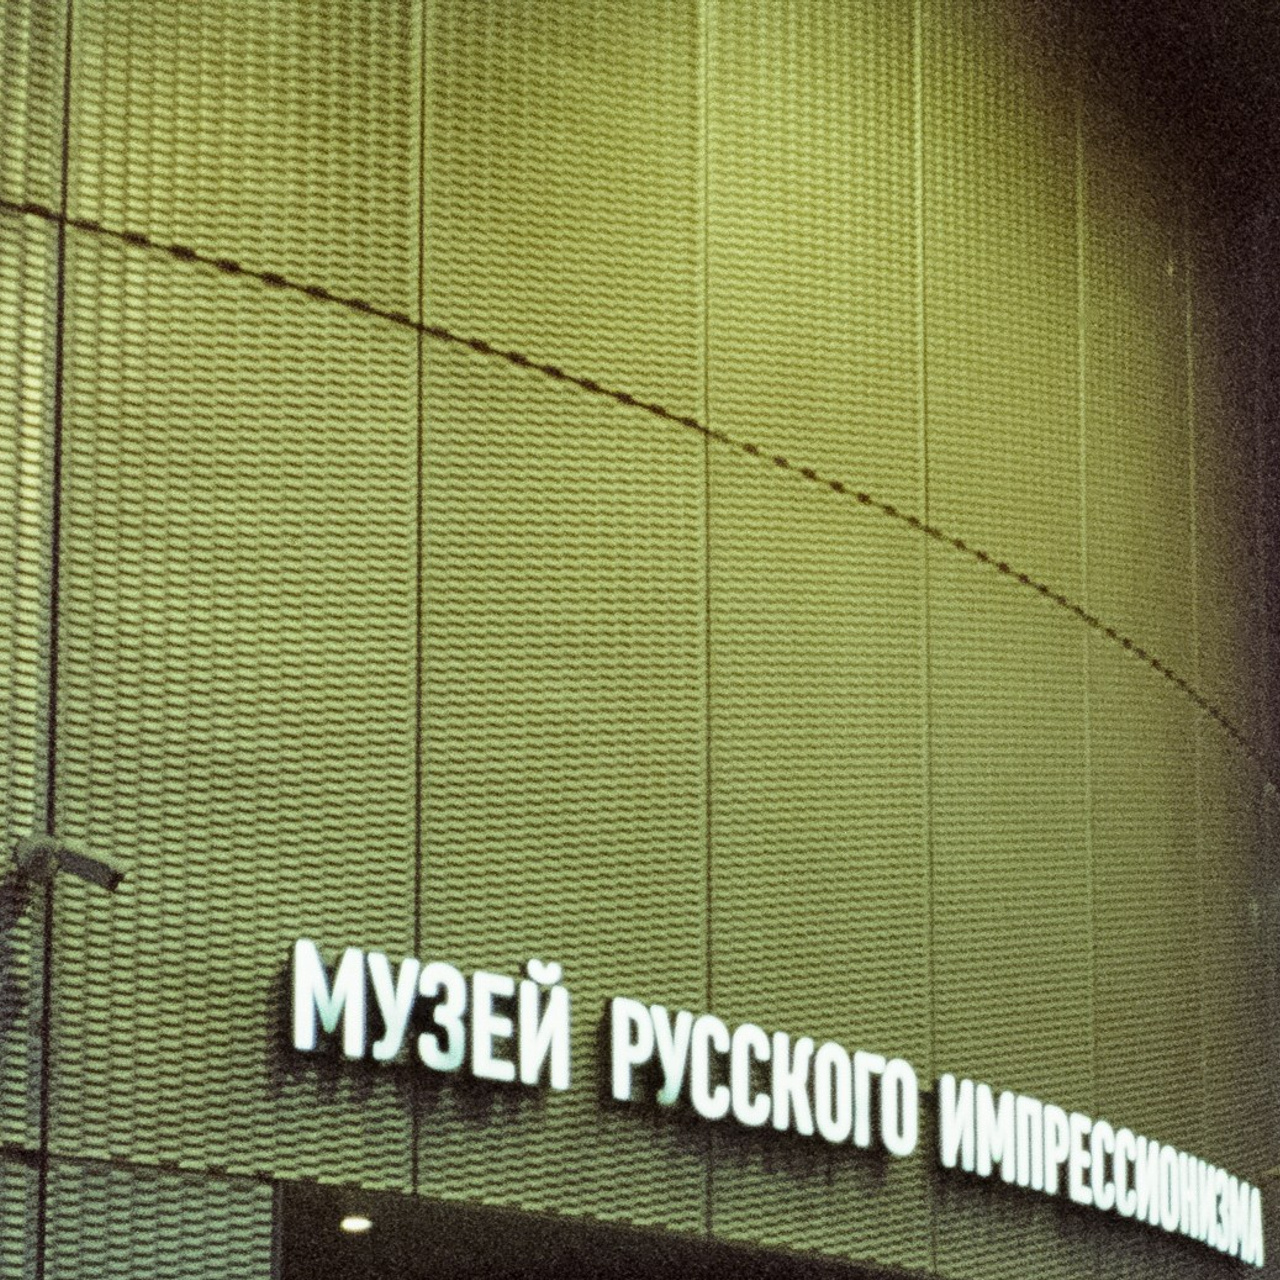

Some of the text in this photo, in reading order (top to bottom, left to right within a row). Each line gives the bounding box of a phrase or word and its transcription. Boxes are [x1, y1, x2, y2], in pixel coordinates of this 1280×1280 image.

[293, 938, 1266, 1269] МУЗЕЙ РУССКОГО ИМПРЕССИОНИЗМА
